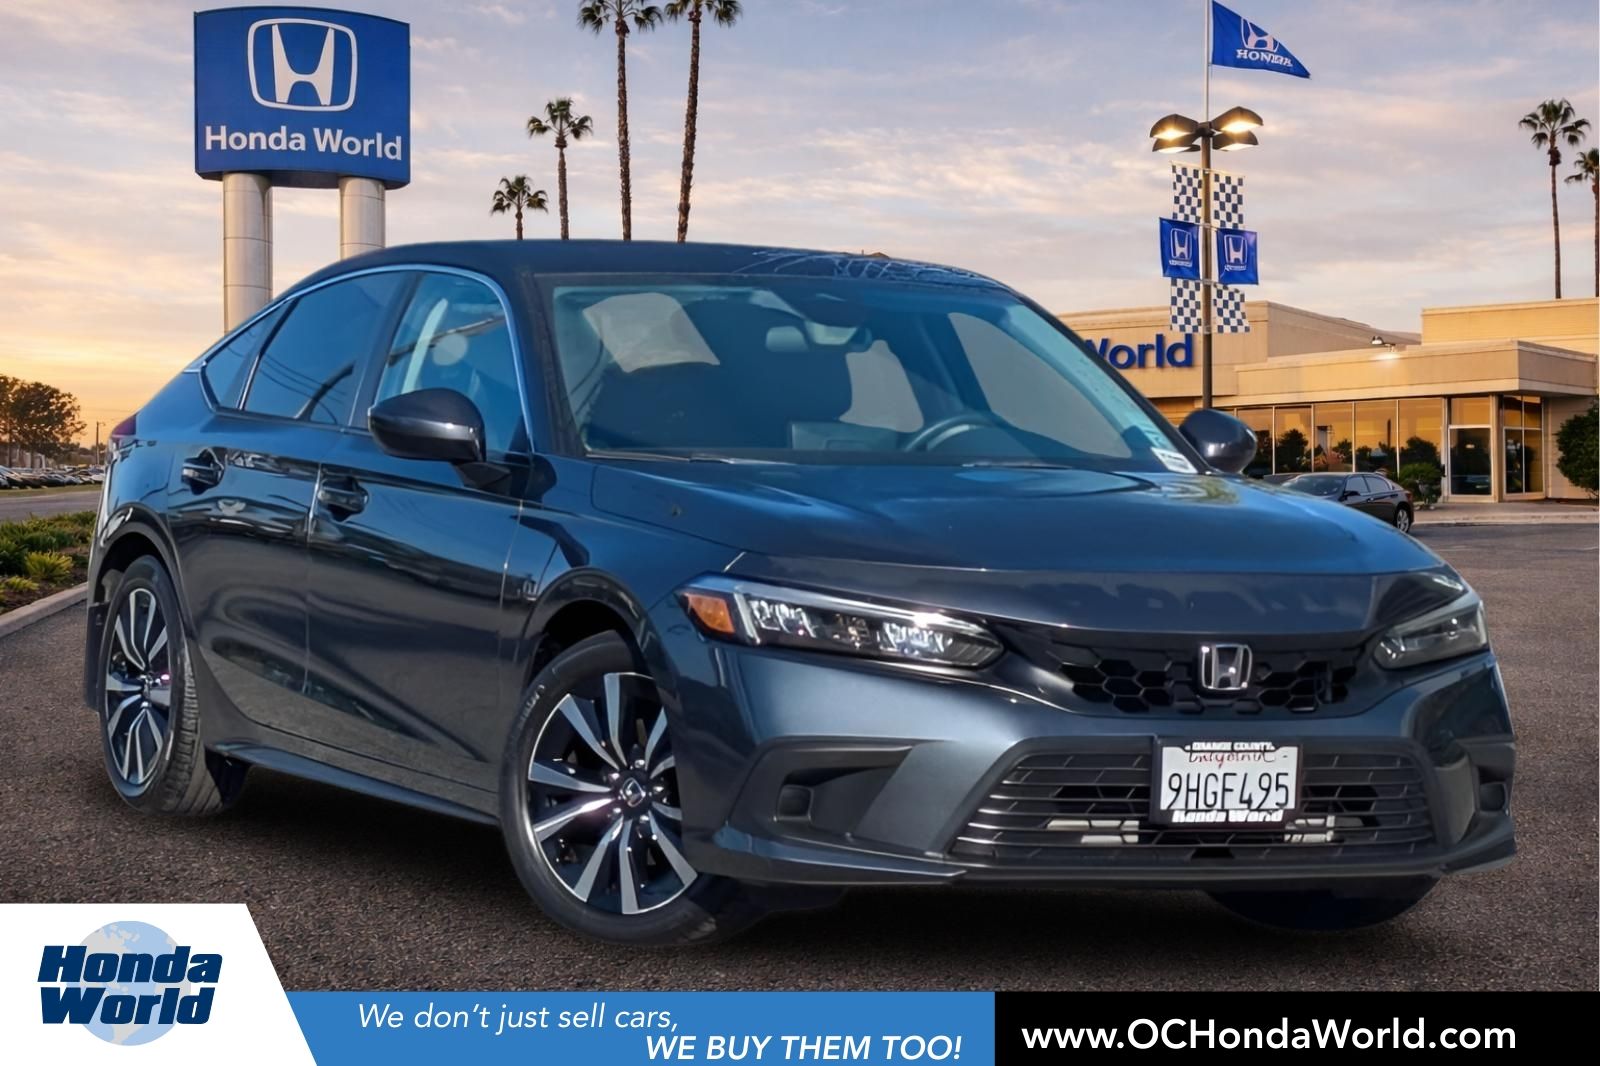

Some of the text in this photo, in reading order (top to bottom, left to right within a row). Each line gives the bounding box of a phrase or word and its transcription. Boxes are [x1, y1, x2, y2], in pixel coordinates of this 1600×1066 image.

[205, 125, 402, 160] Honda World
[1167, 772, 1289, 809] 9HGF495
[1172, 809, 1284, 823] Honda World
